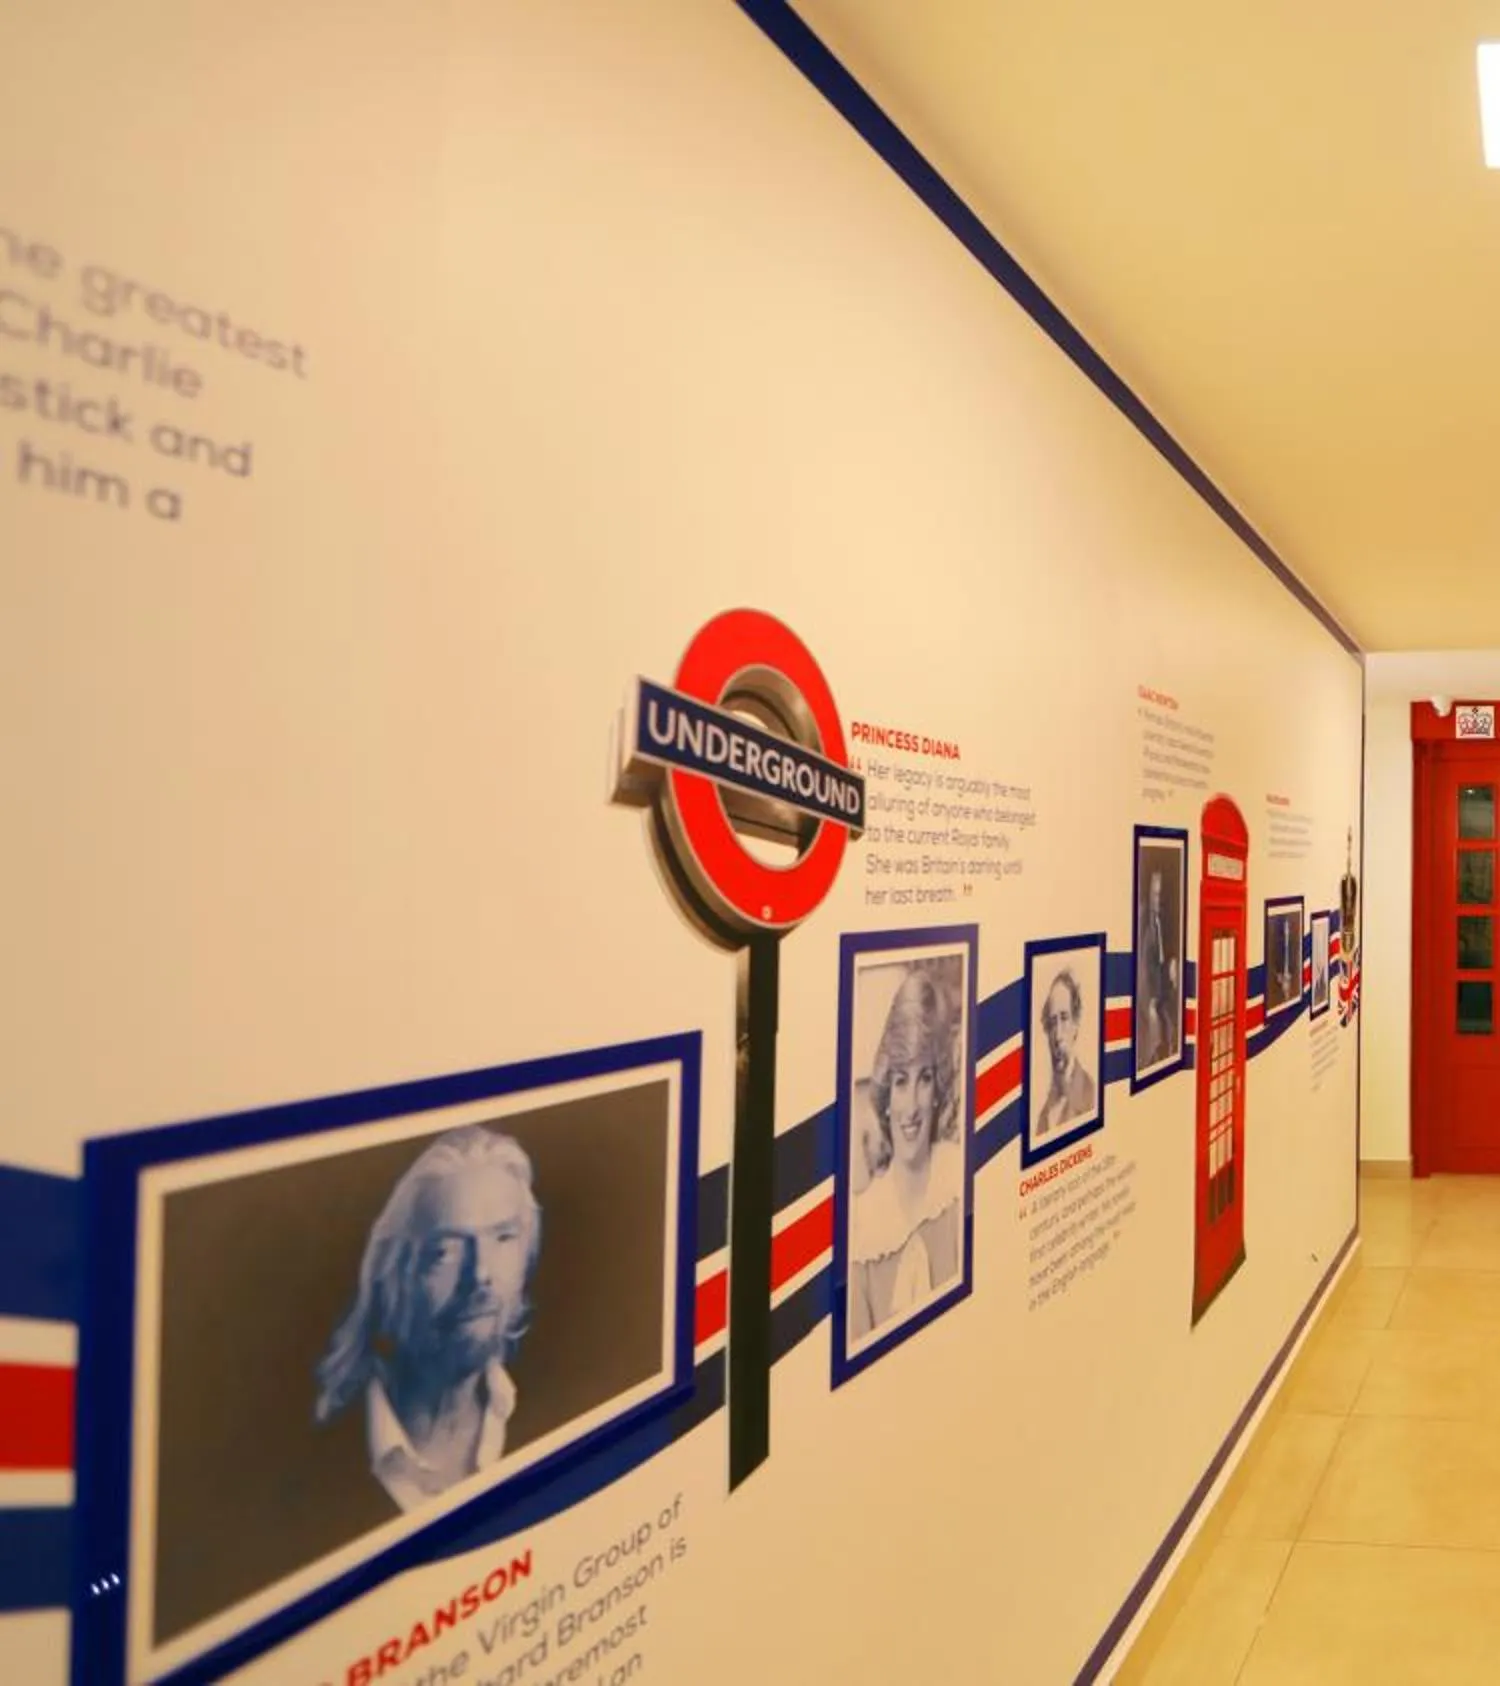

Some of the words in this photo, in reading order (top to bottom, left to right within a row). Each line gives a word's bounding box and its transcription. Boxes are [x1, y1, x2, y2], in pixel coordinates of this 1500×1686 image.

[0, 288, 204, 400] Charlie
[80, 264, 308, 381] greatest
[18, 438, 130, 509] him
[145, 487, 182, 521] a
[150, 424, 252, 478] and
[647, 700, 861, 817] UNDERGROUND
[851, 721, 919, 753] PRINCESS
[921, 737, 961, 760] DIANA
[1019, 1162, 1059, 1197] CHARLES
[346, 1548, 534, 1686] BRANSON
[477, 1582, 566, 1656] Virgin
[573, 1521, 652, 1589] Group
[657, 1490, 683, 1530] of
[556, 1553, 665, 1648] Branson
[668, 1536, 688, 1564] is
